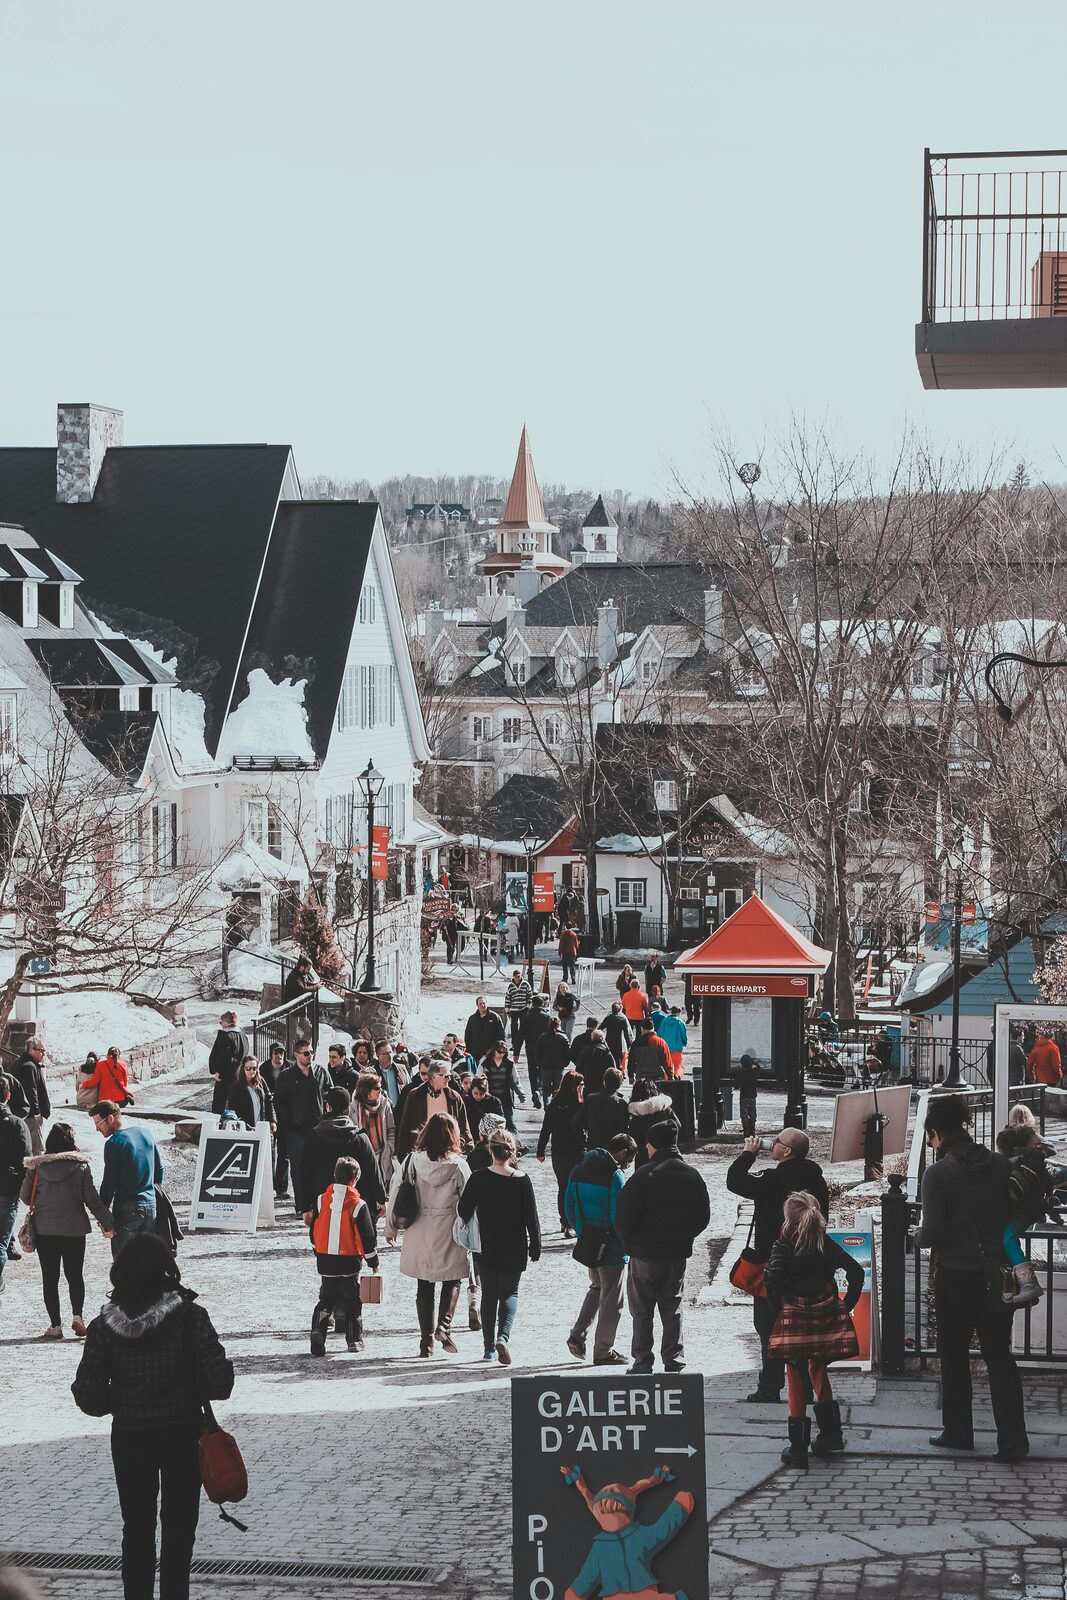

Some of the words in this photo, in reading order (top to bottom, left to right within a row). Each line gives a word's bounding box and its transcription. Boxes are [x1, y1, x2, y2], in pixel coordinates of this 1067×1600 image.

[693, 984, 709, 992] RUE
[710, 985, 725, 993] DES
[726, 985, 767, 993] REMPARTS
[540, 1424, 647, 1453] D'ART
